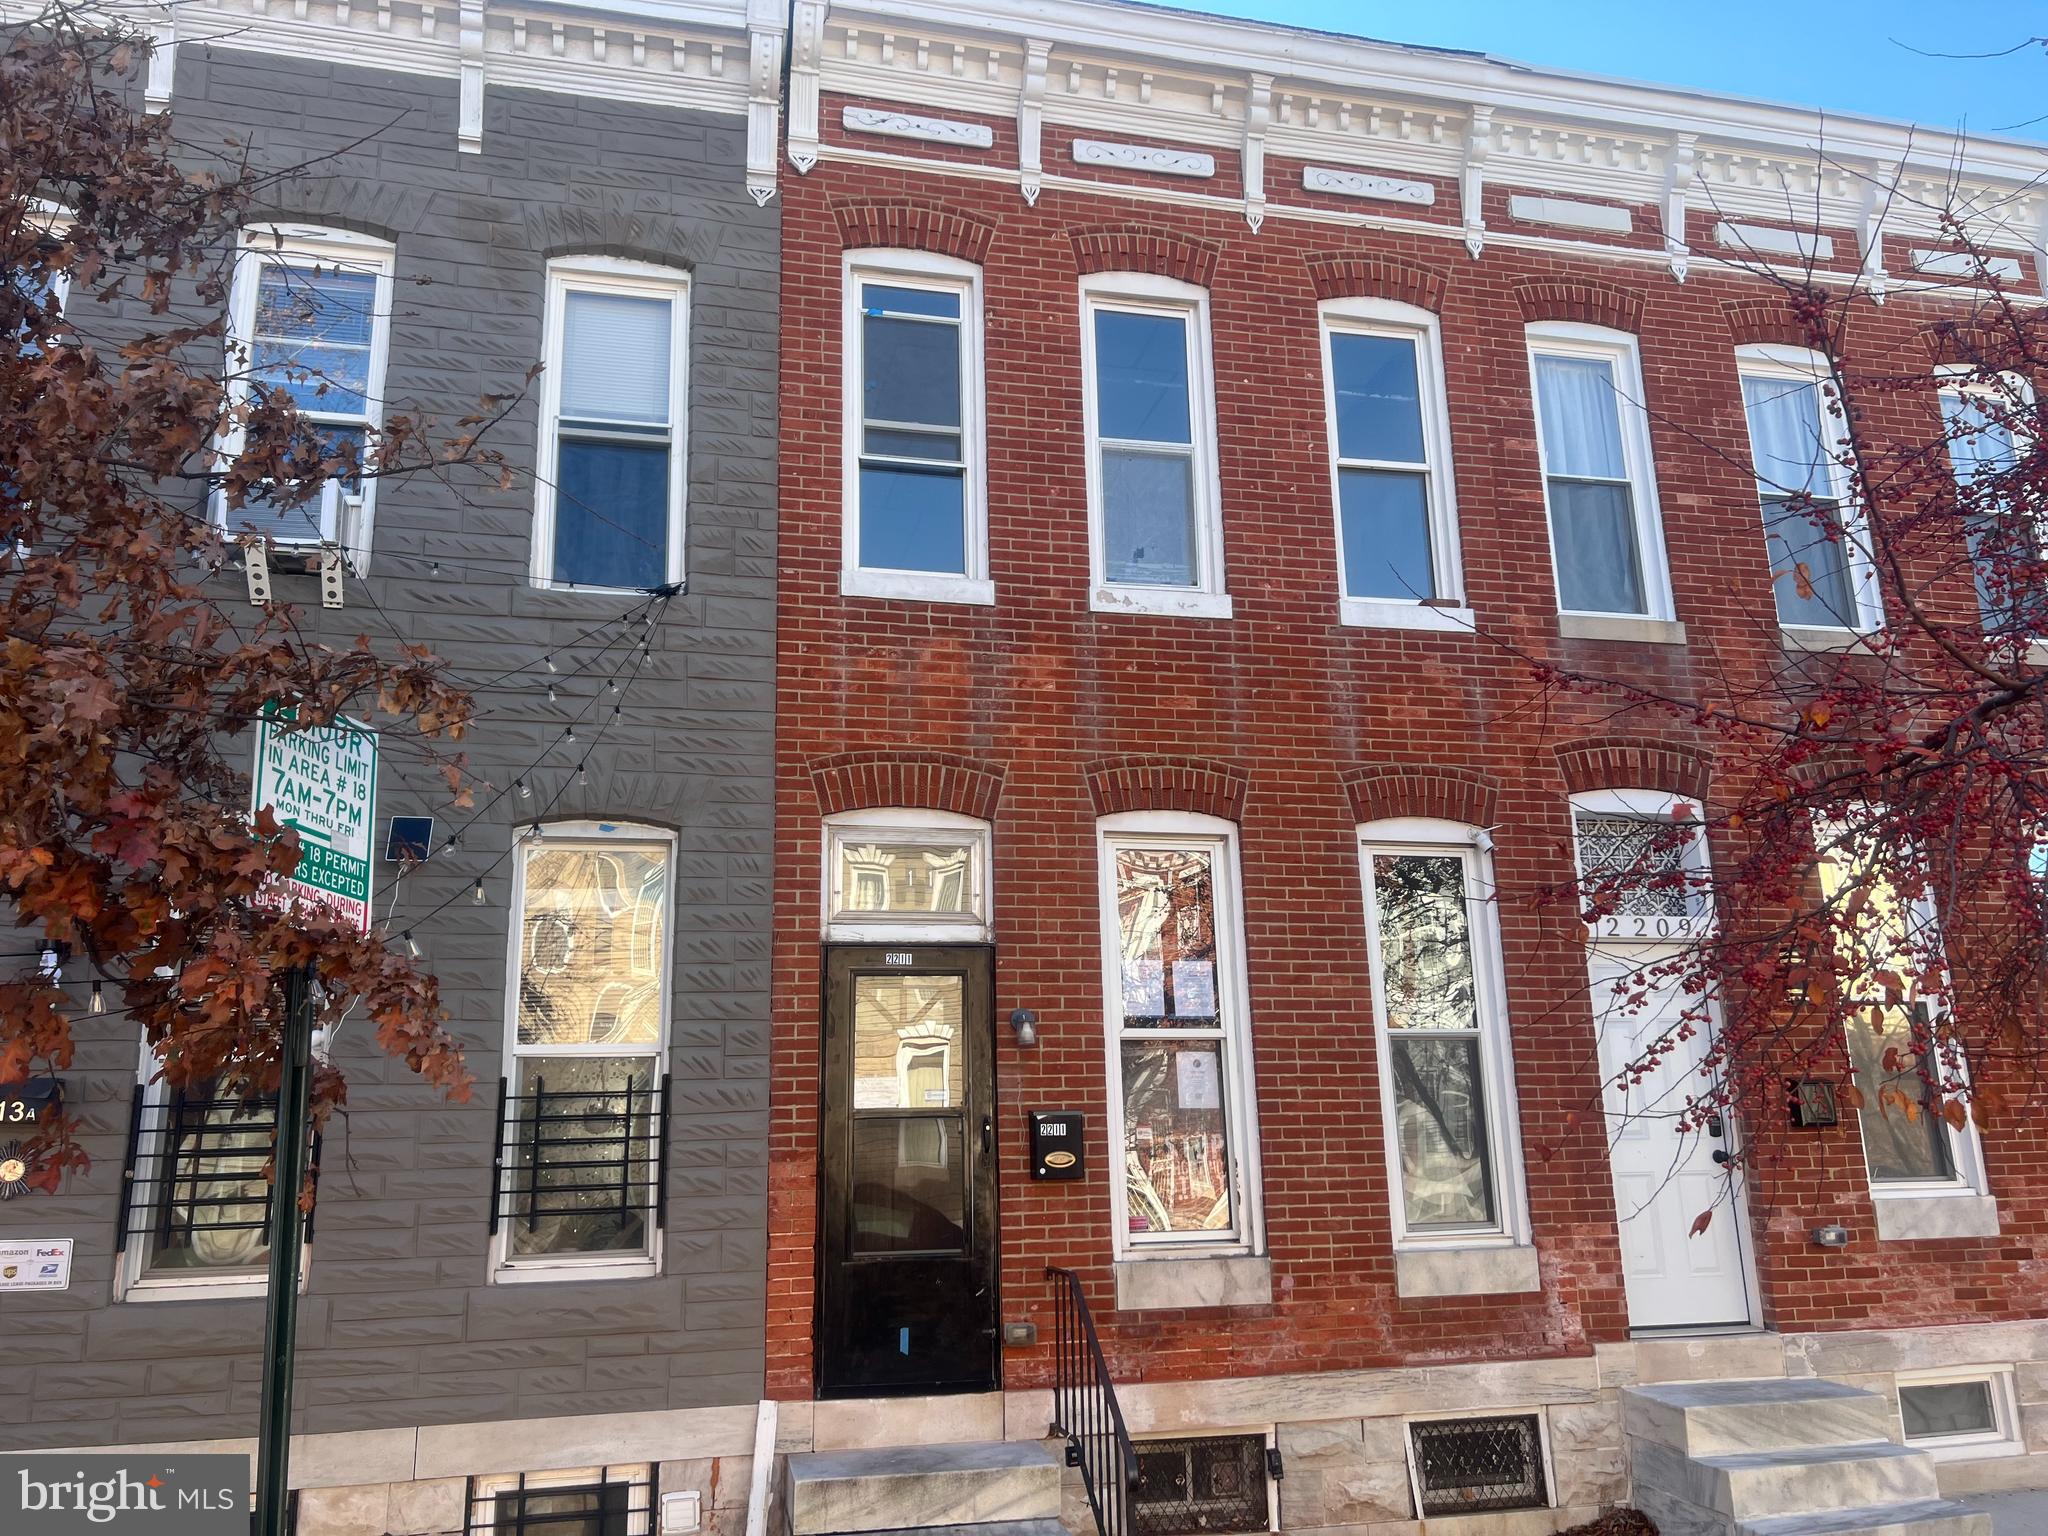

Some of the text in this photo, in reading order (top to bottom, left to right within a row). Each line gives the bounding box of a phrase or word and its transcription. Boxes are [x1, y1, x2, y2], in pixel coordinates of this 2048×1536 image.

[311, 722, 362, 758] OUR
[268, 744, 366, 801] IN AREA # 18
[336, 751, 369, 781] LIMIT
[272, 767, 362, 827] 7AM-7PM
[276, 798, 354, 838] MON THRU FRI
[309, 846, 321, 863] 18
[325, 853, 367, 879] PERMIT
[312, 866, 365, 898] EXCEPTED
[326, 892, 362, 917] DURING
[1606, 917, 1692, 938] 2209
[886, 953, 912, 964] 2211
[1041, 1124, 1066, 1135] 2211
